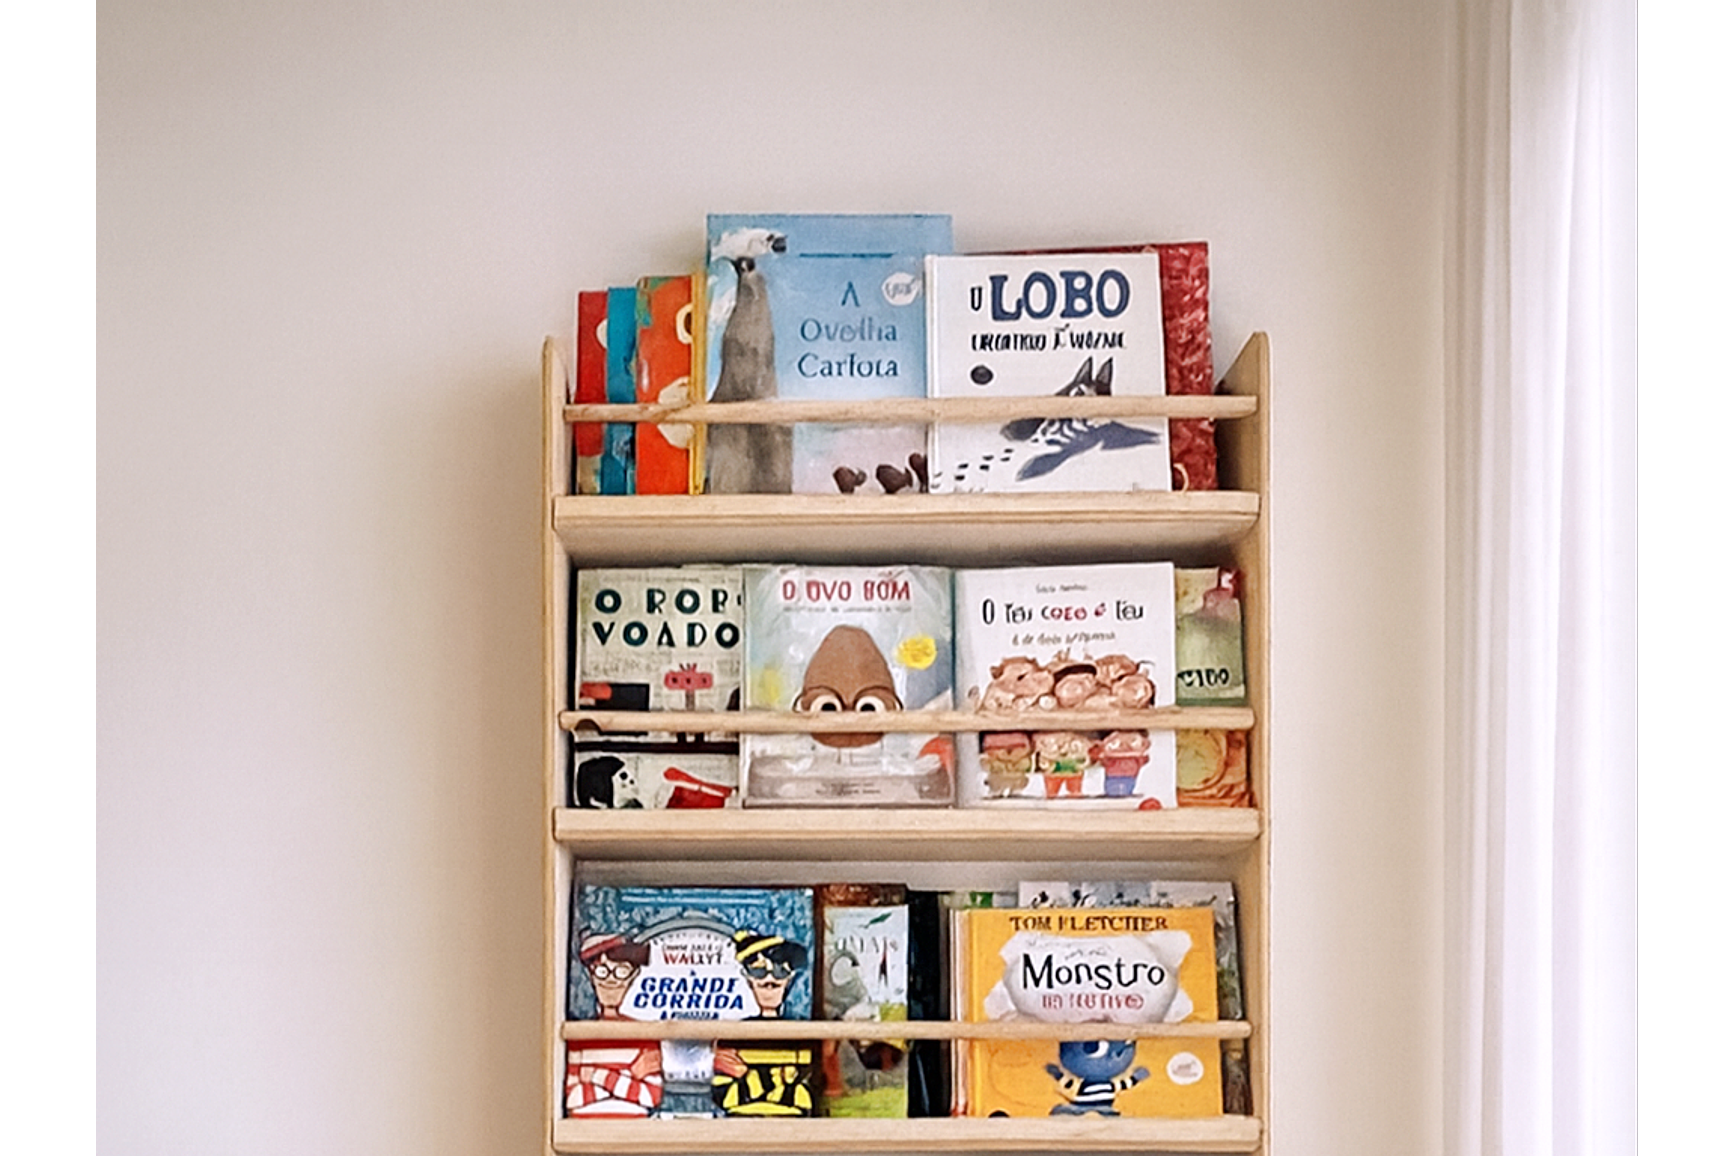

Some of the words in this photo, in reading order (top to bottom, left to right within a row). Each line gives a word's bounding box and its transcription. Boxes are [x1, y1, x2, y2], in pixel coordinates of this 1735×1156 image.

[989, 269, 1131, 322] LOBO
[797, 352, 900, 378] Carlota
[594, 588, 622, 614] O
[1022, 952, 1165, 991] Monstro
[633, 993, 744, 1010] CORRIDA
